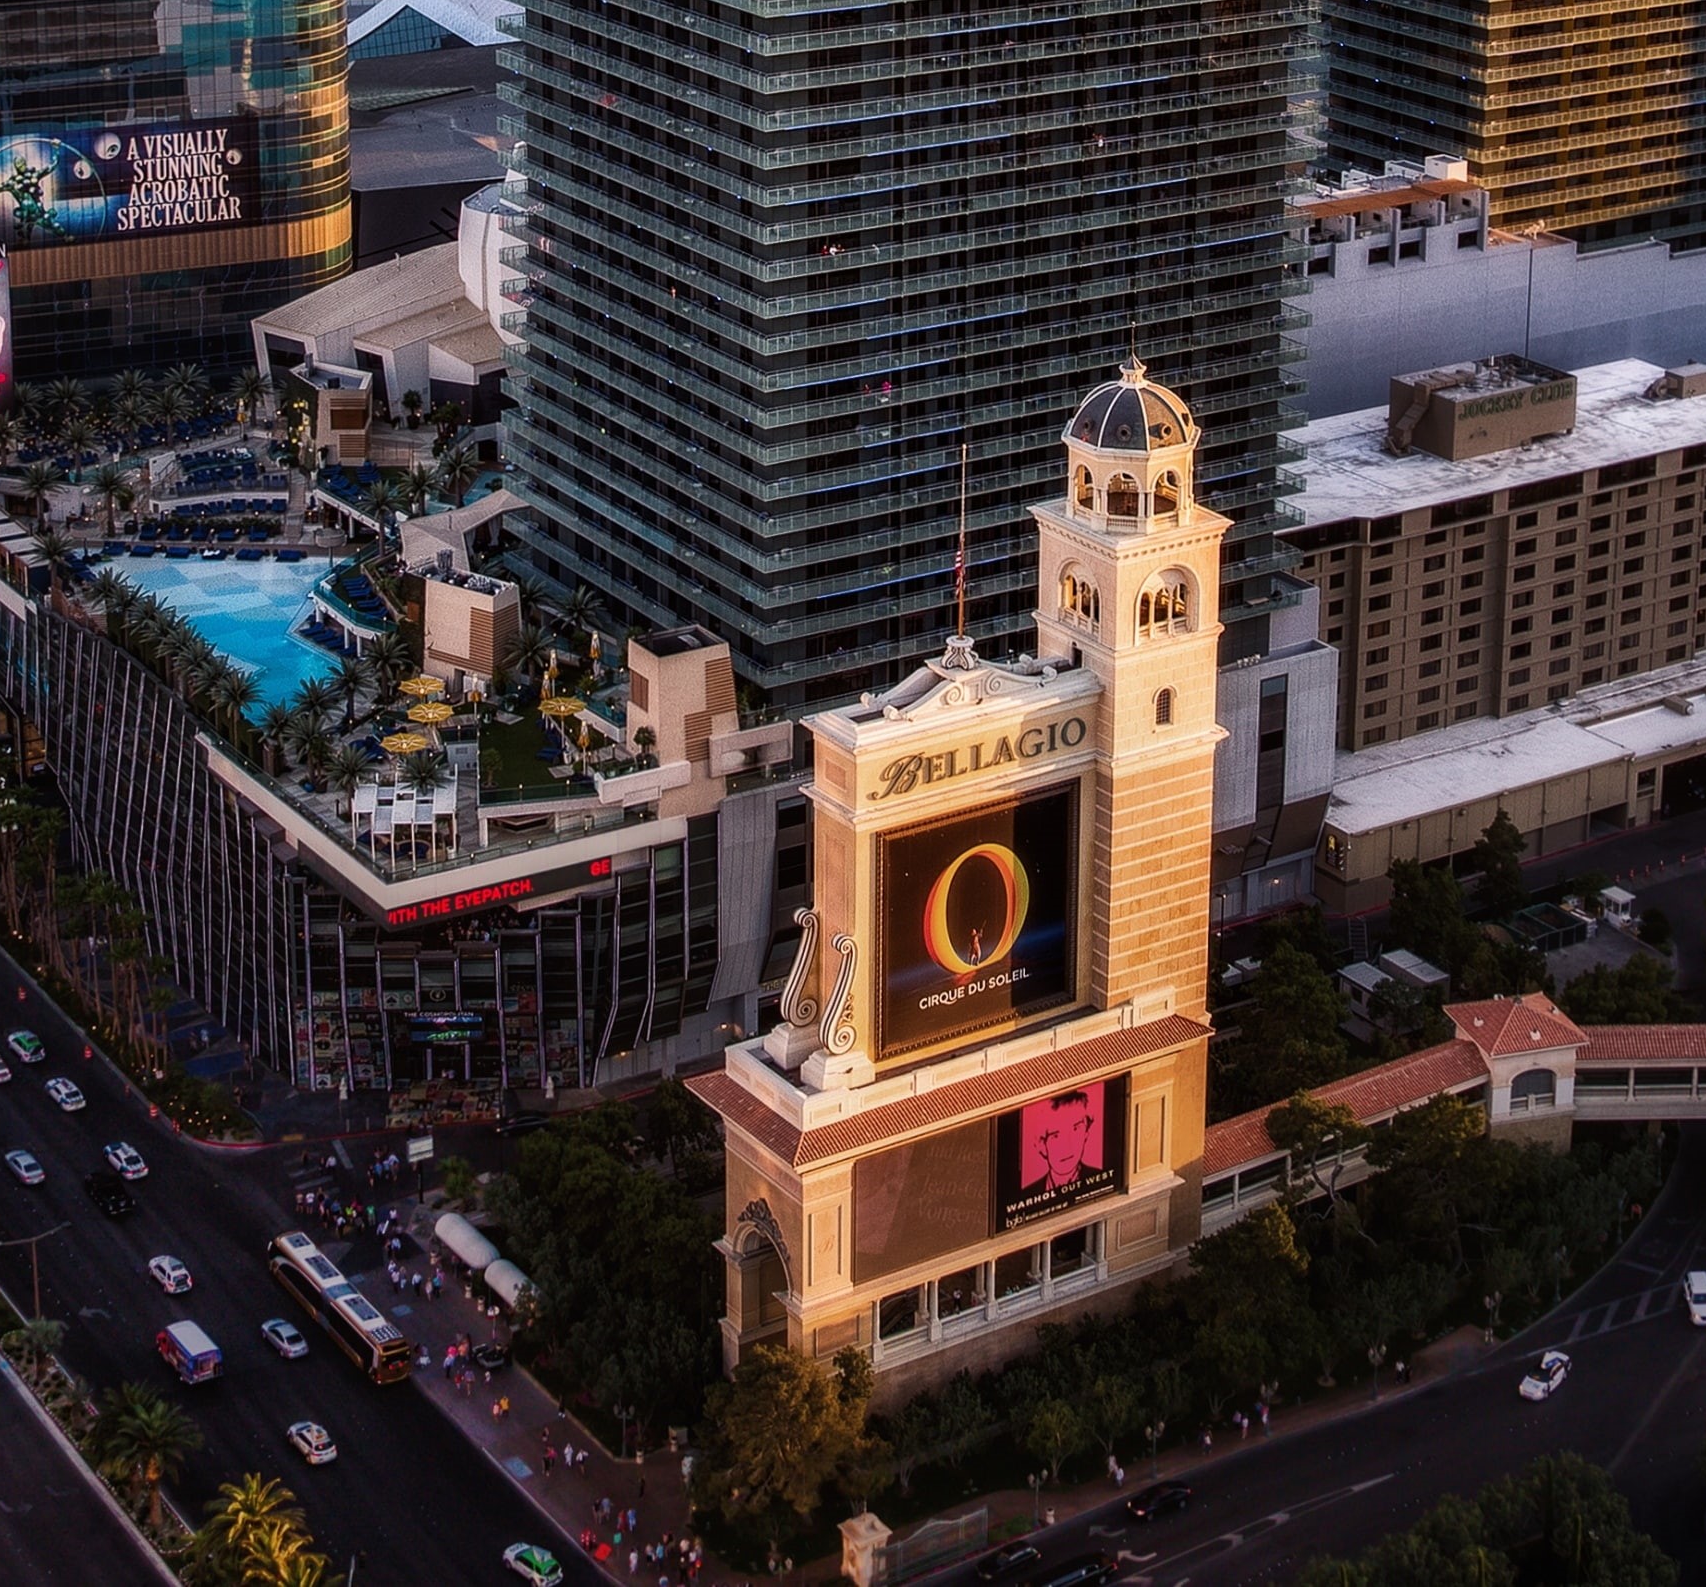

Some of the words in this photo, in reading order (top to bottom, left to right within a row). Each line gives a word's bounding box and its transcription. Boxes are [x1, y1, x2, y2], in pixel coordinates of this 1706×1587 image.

[126, 137, 141, 161] A
[143, 128, 228, 158] VISUALLY
[133, 152, 223, 183] STUNNING
[127, 174, 230, 207] ACROBATIC
[117, 196, 242, 231] SPECTACULAR
[1458, 391, 1525, 421] JOCKEY
[1530, 381, 1574, 406] CLUB
[420, 897, 452, 918] THE
[454, 878, 534, 911] EYEPATCH.
[590, 858, 612, 877] GE
[923, 842, 1030, 975] O
[919, 985, 965, 1010] CIRQUE
[968, 979, 987, 994] DU
[988, 967, 1030, 990] SOLEIL
[1006, 1190, 1057, 1213] WARHOL
[1060, 1180, 1082, 1195] OUT
[1085, 1169, 1115, 1186] WEST
